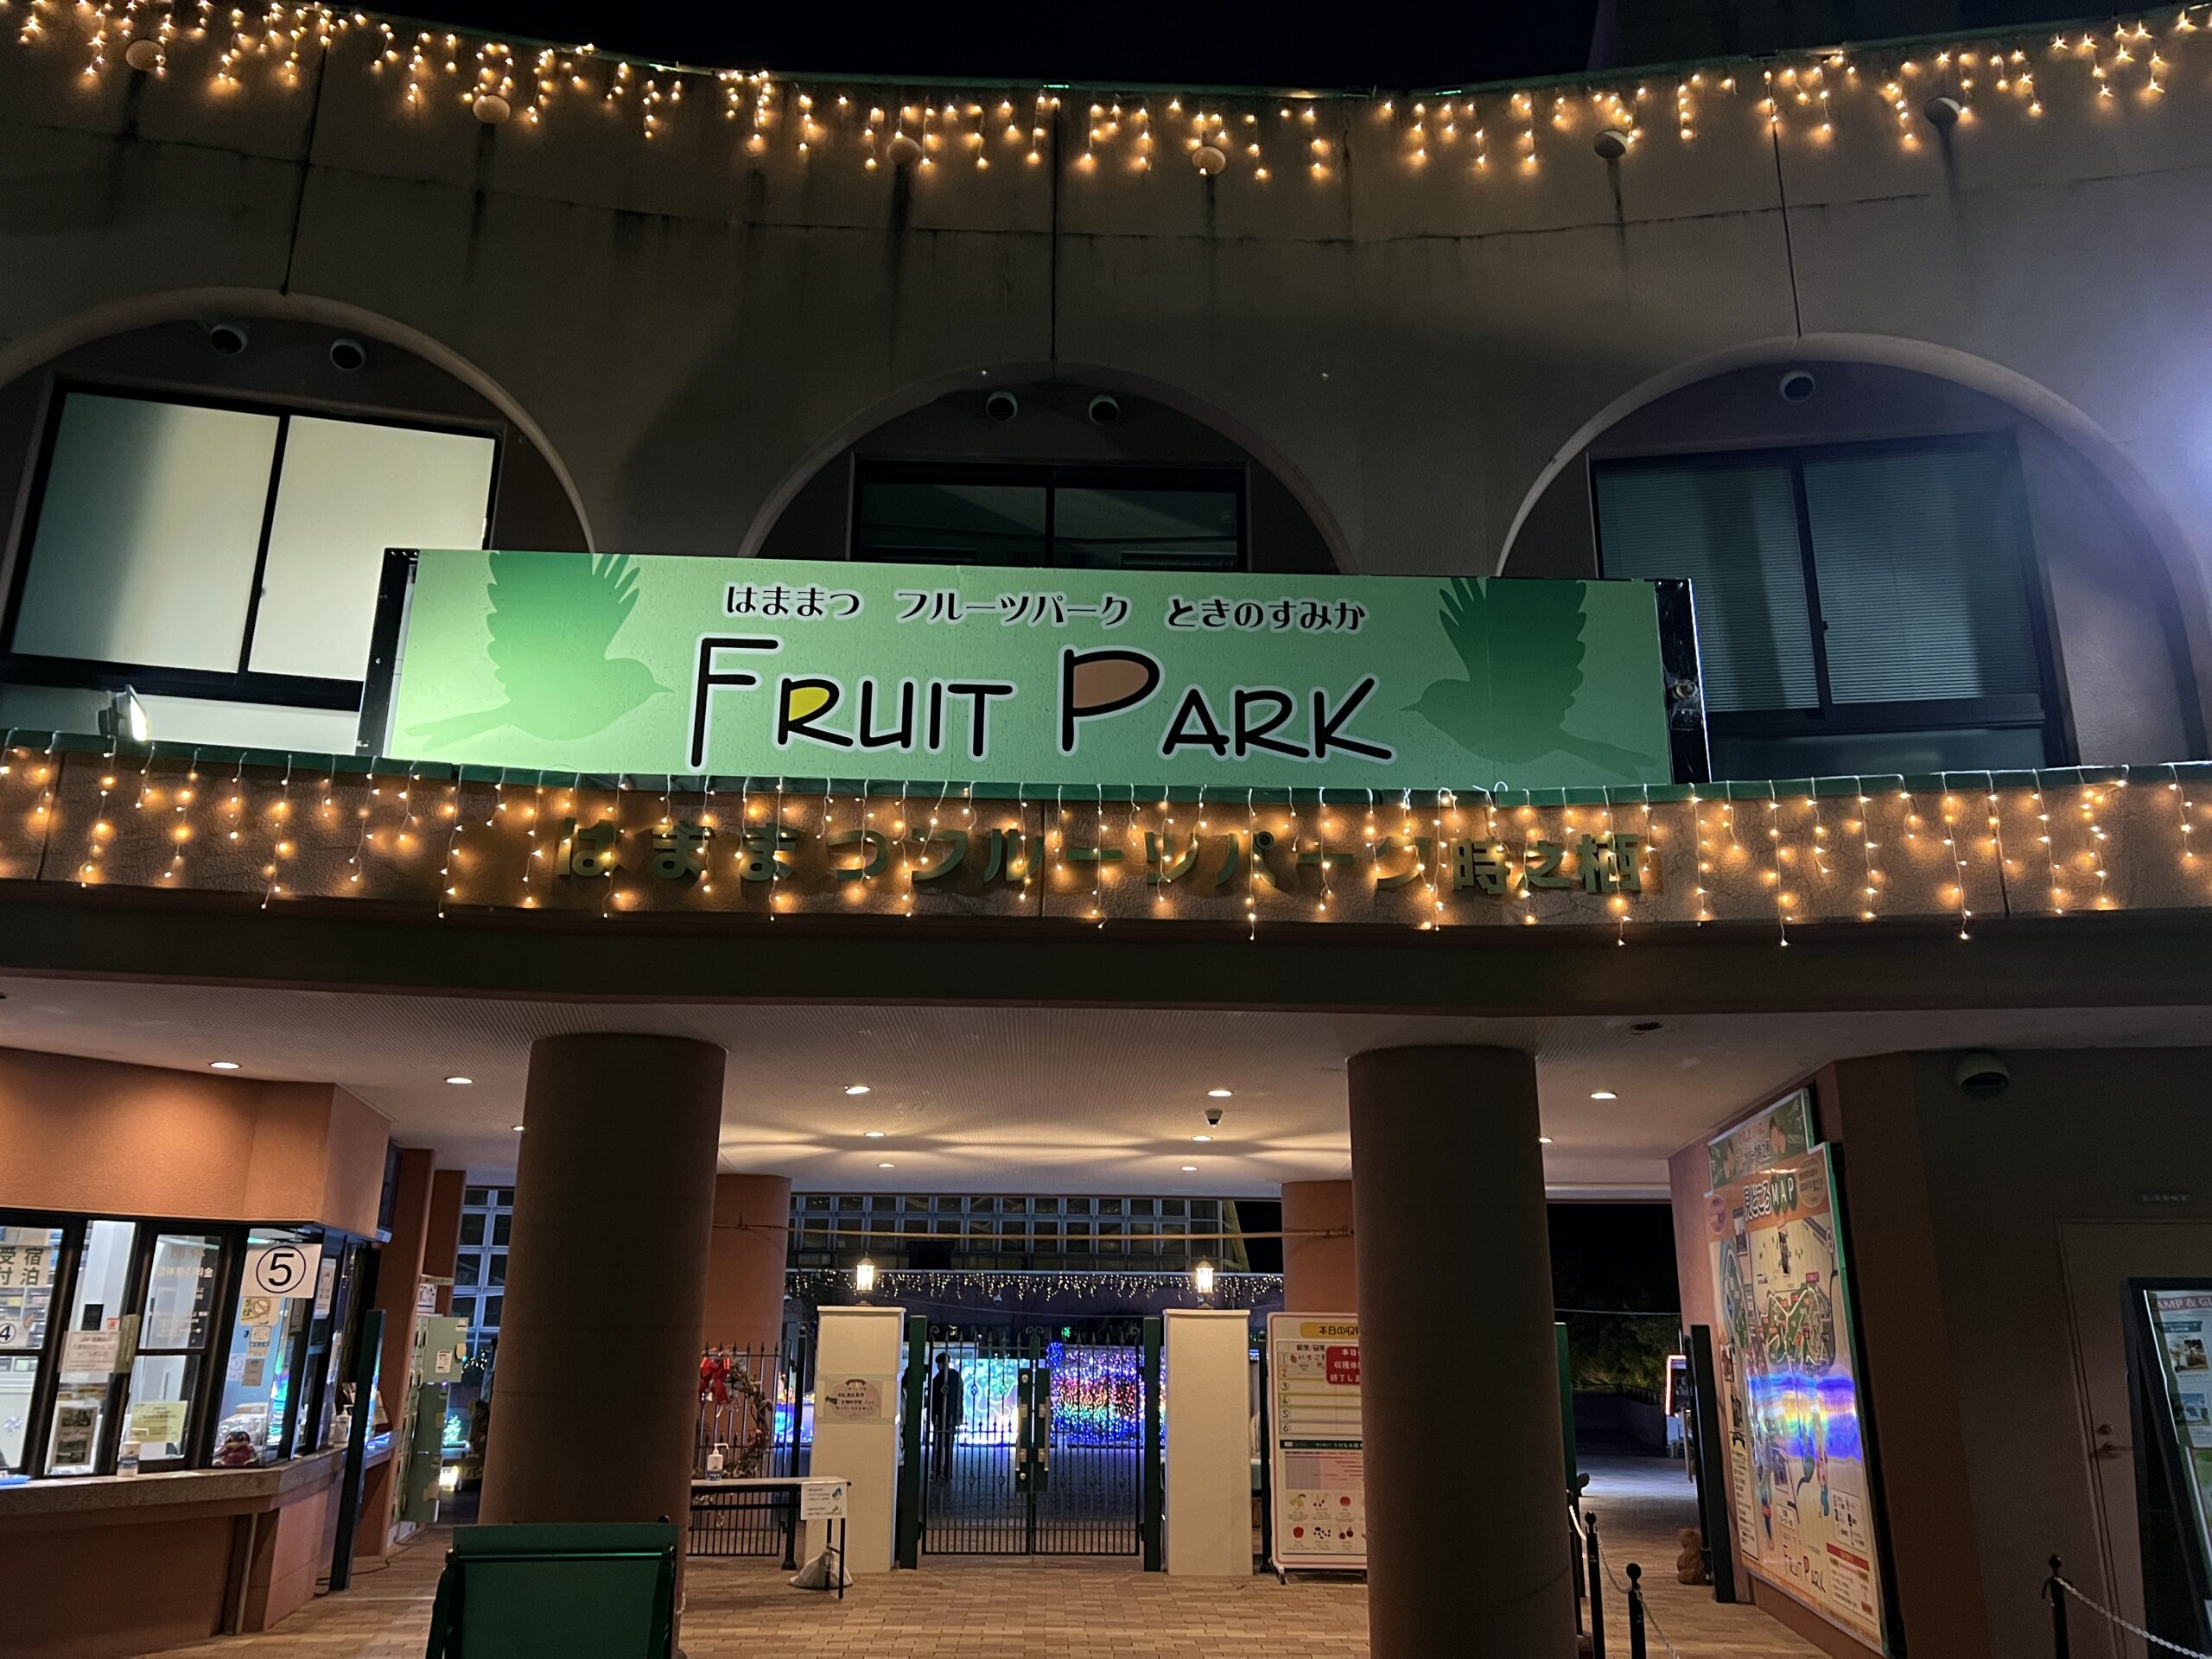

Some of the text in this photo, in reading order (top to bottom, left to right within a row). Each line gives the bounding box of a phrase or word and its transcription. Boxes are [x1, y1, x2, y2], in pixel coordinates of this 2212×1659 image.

[726, 585, 1366, 632] はままつ フルーツパーク ときのすみか
[688, 638, 1393, 767] FRUIT PARK
[21, 1248, 44, 1287] 宿泊
